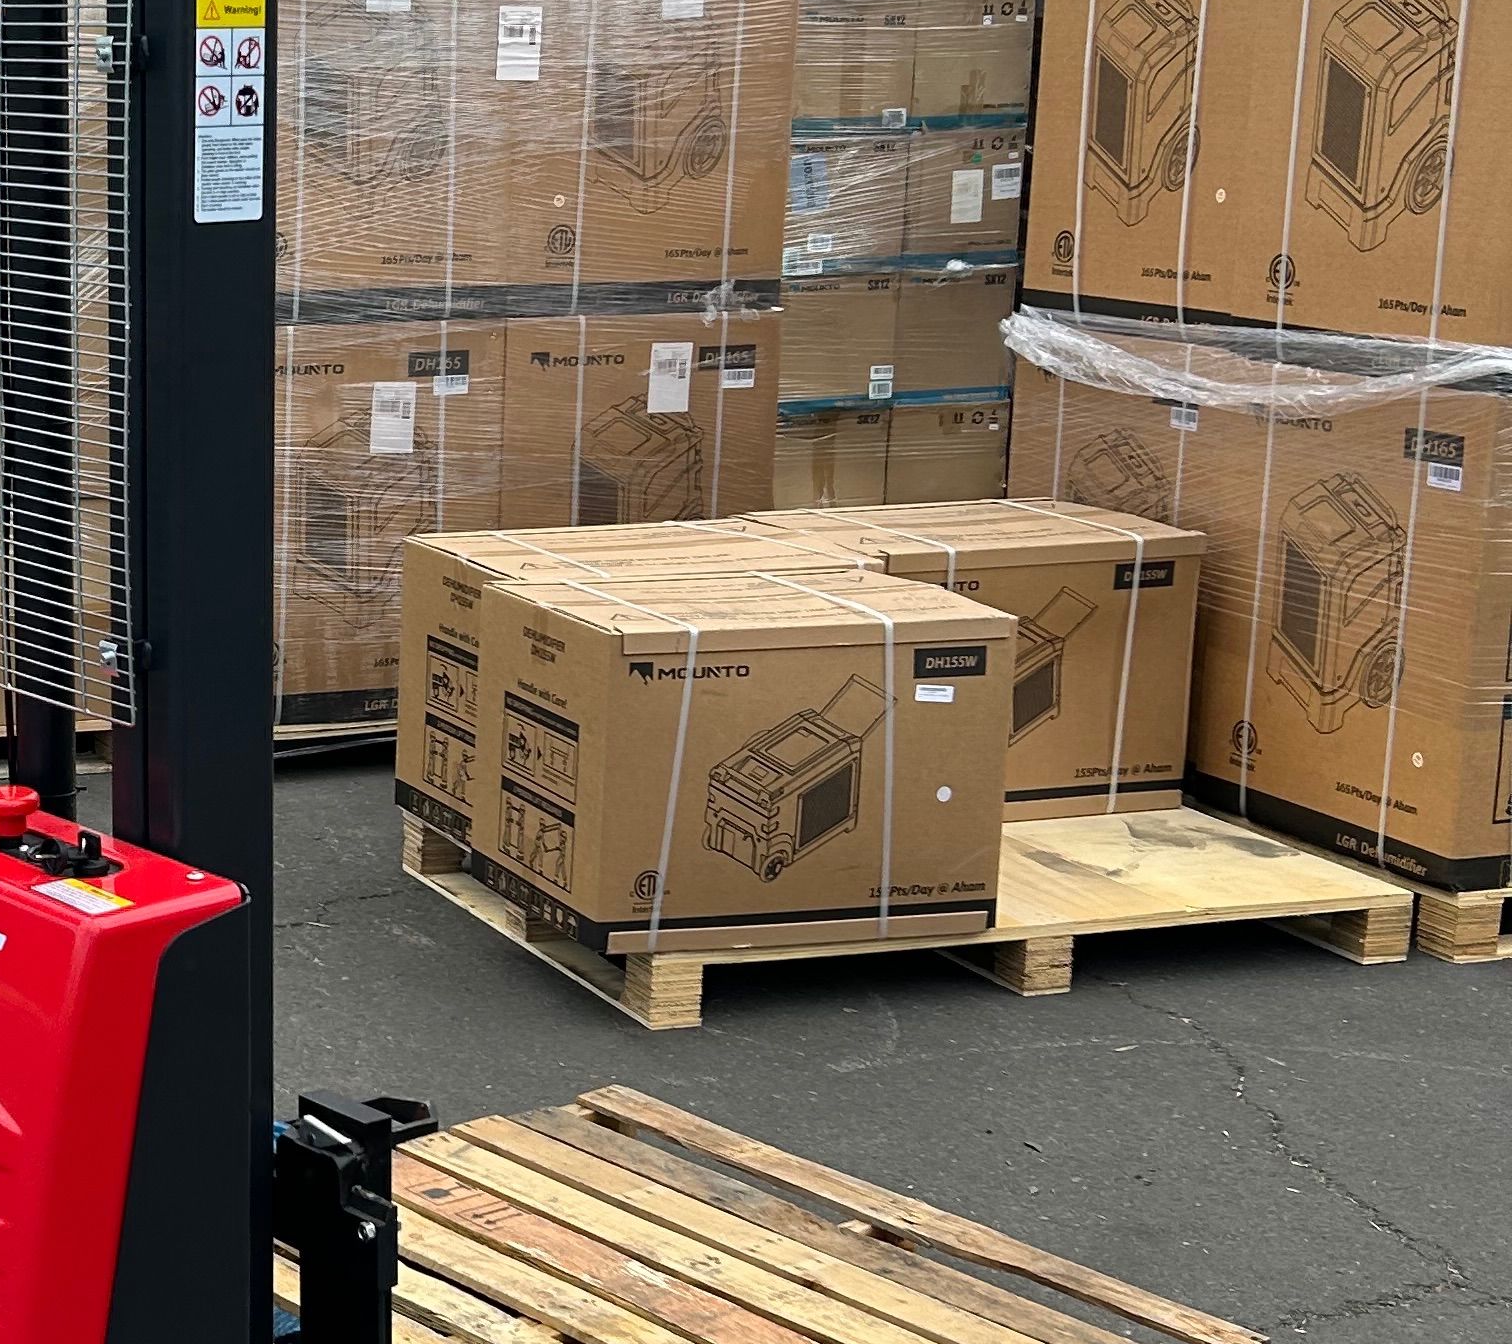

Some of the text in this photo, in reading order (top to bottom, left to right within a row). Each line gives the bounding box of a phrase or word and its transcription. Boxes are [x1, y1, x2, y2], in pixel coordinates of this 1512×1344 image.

[1123, 568, 1169, 582] D155W
[925, 655, 979, 670] DH155W
[1335, 832, 1357, 851] LGR
[868, 884, 934, 899] 15Pts/Day
[951, 880, 986, 894] Aham
